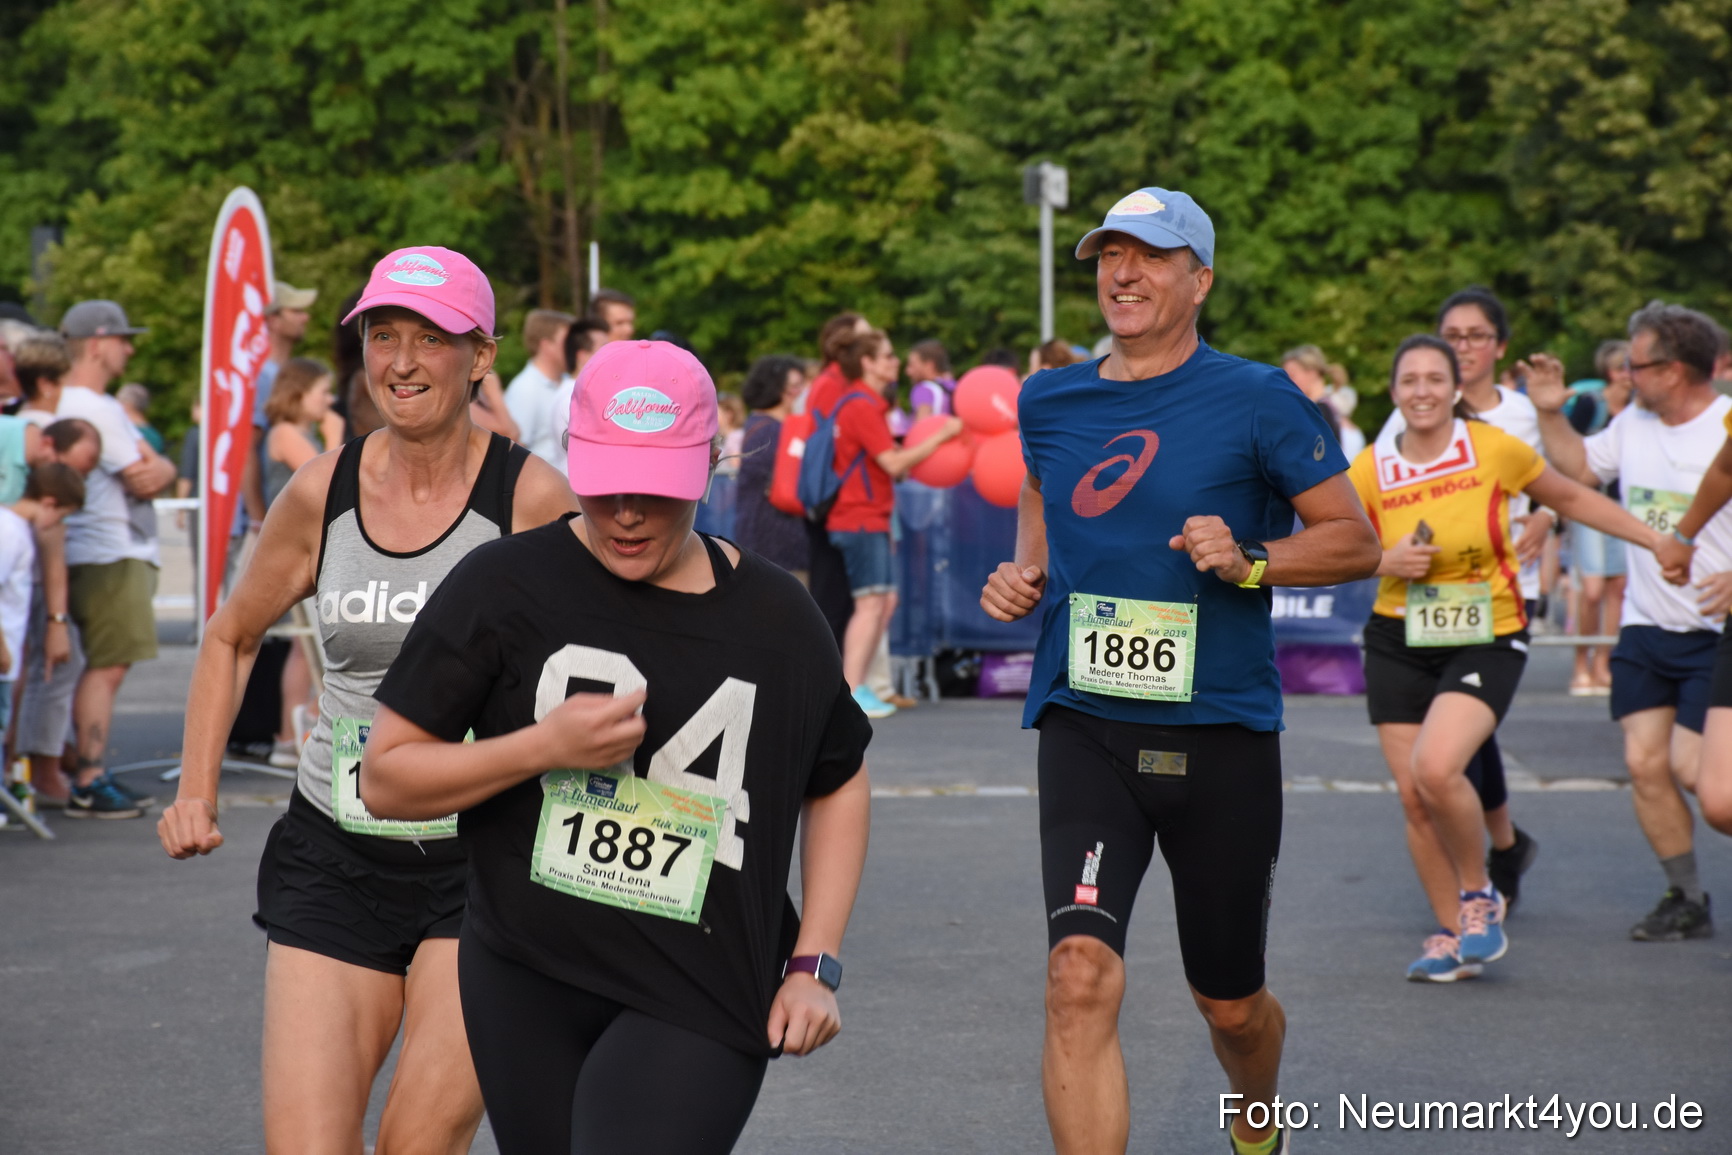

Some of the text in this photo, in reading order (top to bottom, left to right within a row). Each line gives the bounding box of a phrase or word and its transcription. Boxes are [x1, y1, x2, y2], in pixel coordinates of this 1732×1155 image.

[602, 397, 682, 421] California
[1382, 476, 1482, 511] MAX BÖGL
[321, 580, 428, 625] adid
[1087, 613, 1134, 628] firmenlauf
[1418, 605, 1481, 628] 1678
[1163, 629, 1187, 638] 2019
[1084, 631, 1176, 672] 1886
[1081, 675, 1098, 684] Praxis
[1099, 678, 1113, 686] Dres.
[1116, 680, 1176, 692] Mederer/Schreiber
[1089, 666, 1167, 683] Mederer Thomas
[571, 789, 640, 815] firmenlauf
[675, 824, 708, 838] 2019
[562, 811, 692, 878] 1887
[548, 867, 681, 906] Praxis Dres. Mederer/Schreiber
[582, 863, 651, 888] Sand Lena
